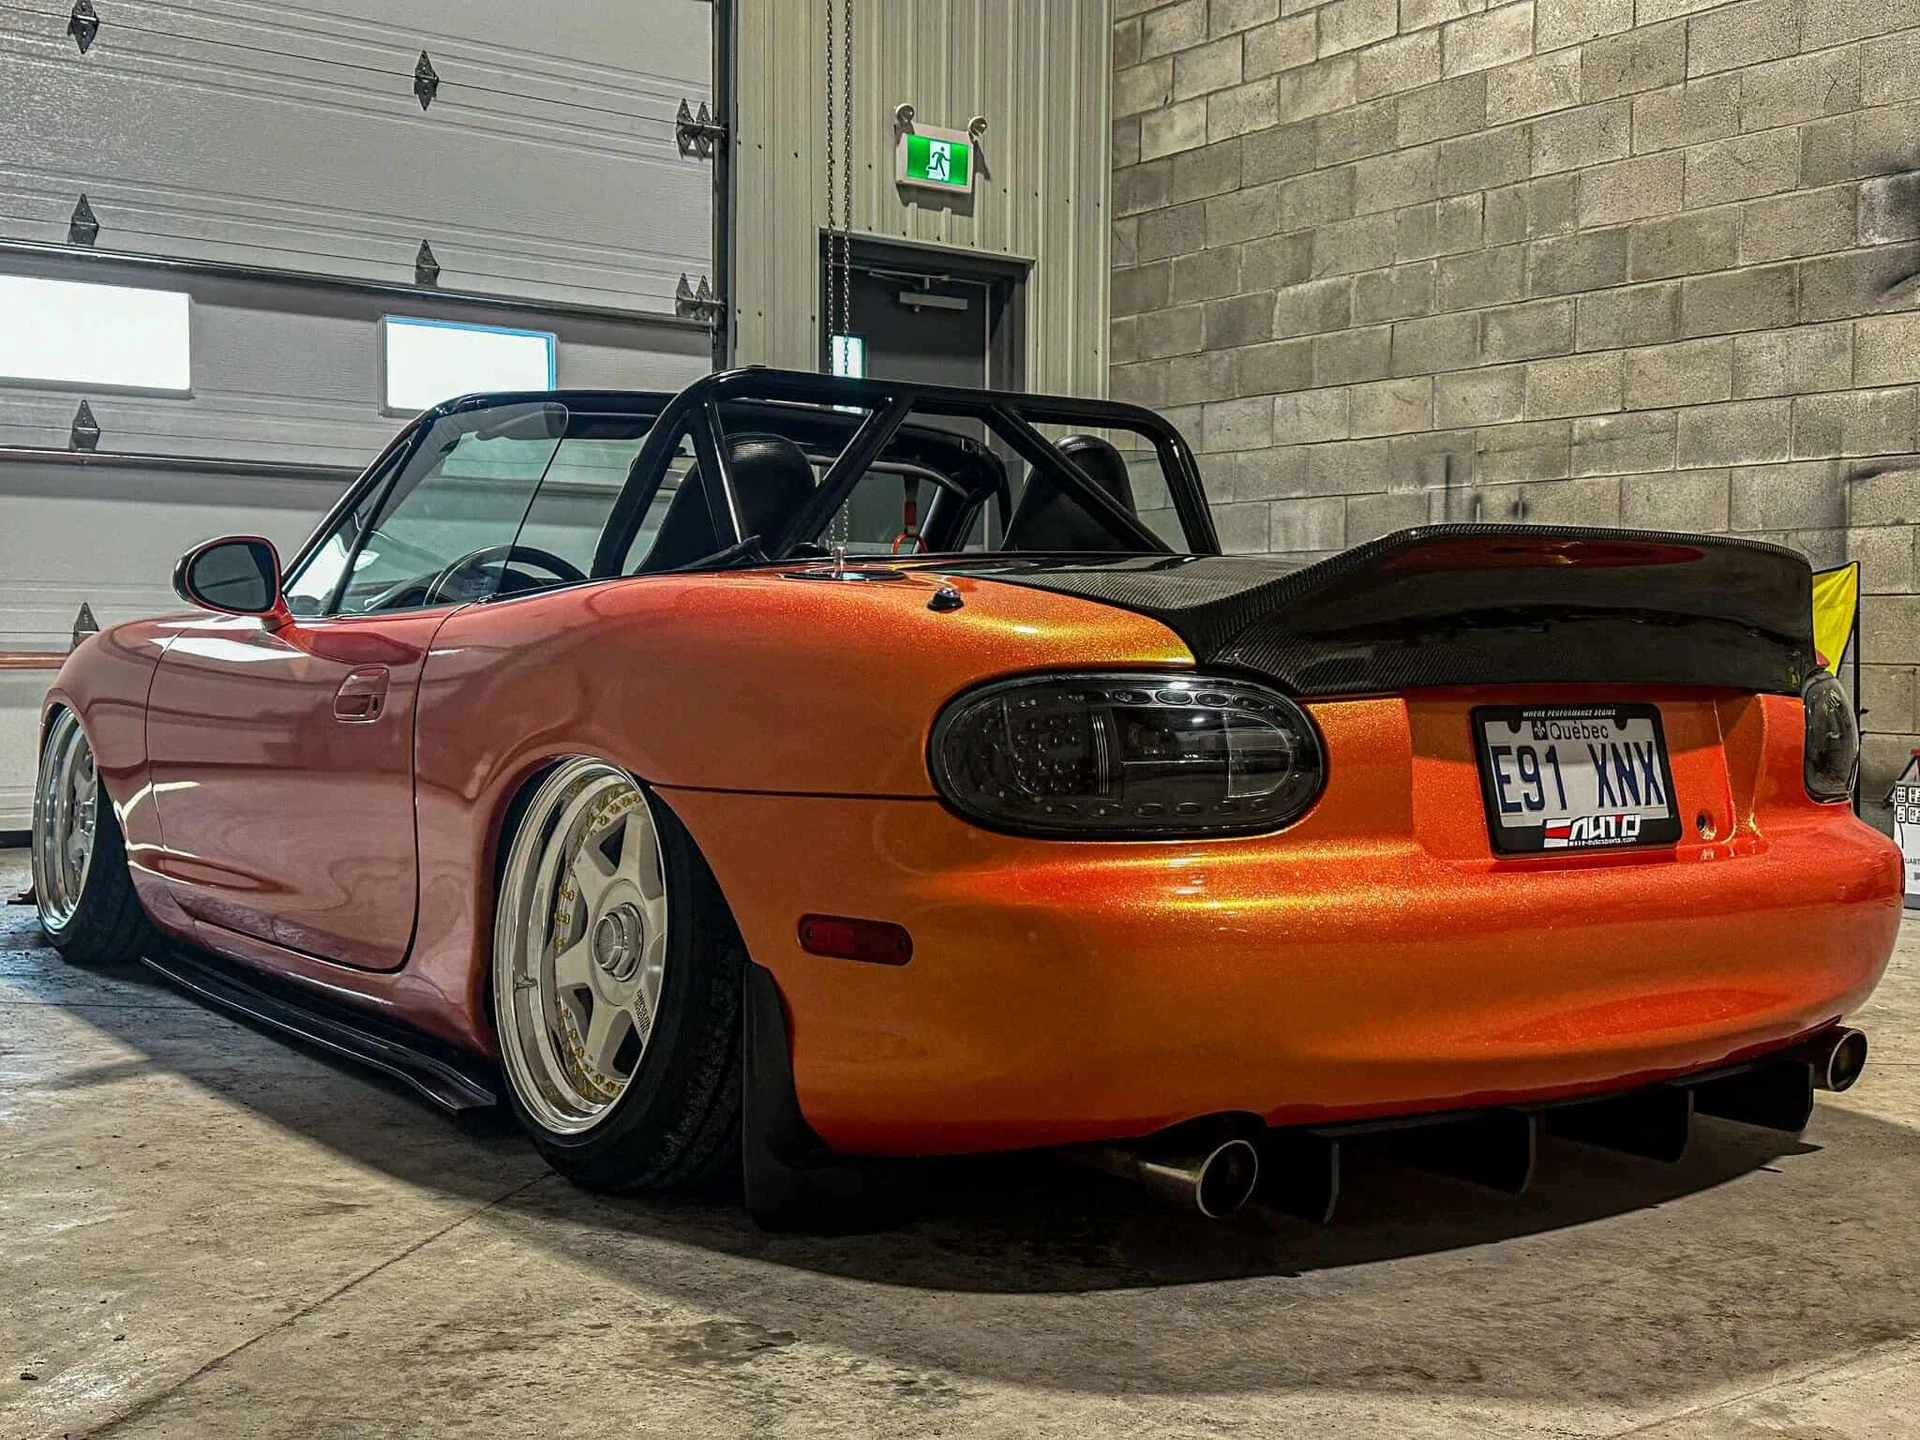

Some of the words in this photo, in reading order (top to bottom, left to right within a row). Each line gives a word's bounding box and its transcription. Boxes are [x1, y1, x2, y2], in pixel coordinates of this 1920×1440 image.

[1549, 720, 1609, 740] Québec
[1491, 745, 1567, 814] E91
[1588, 741, 1665, 808] XNX
